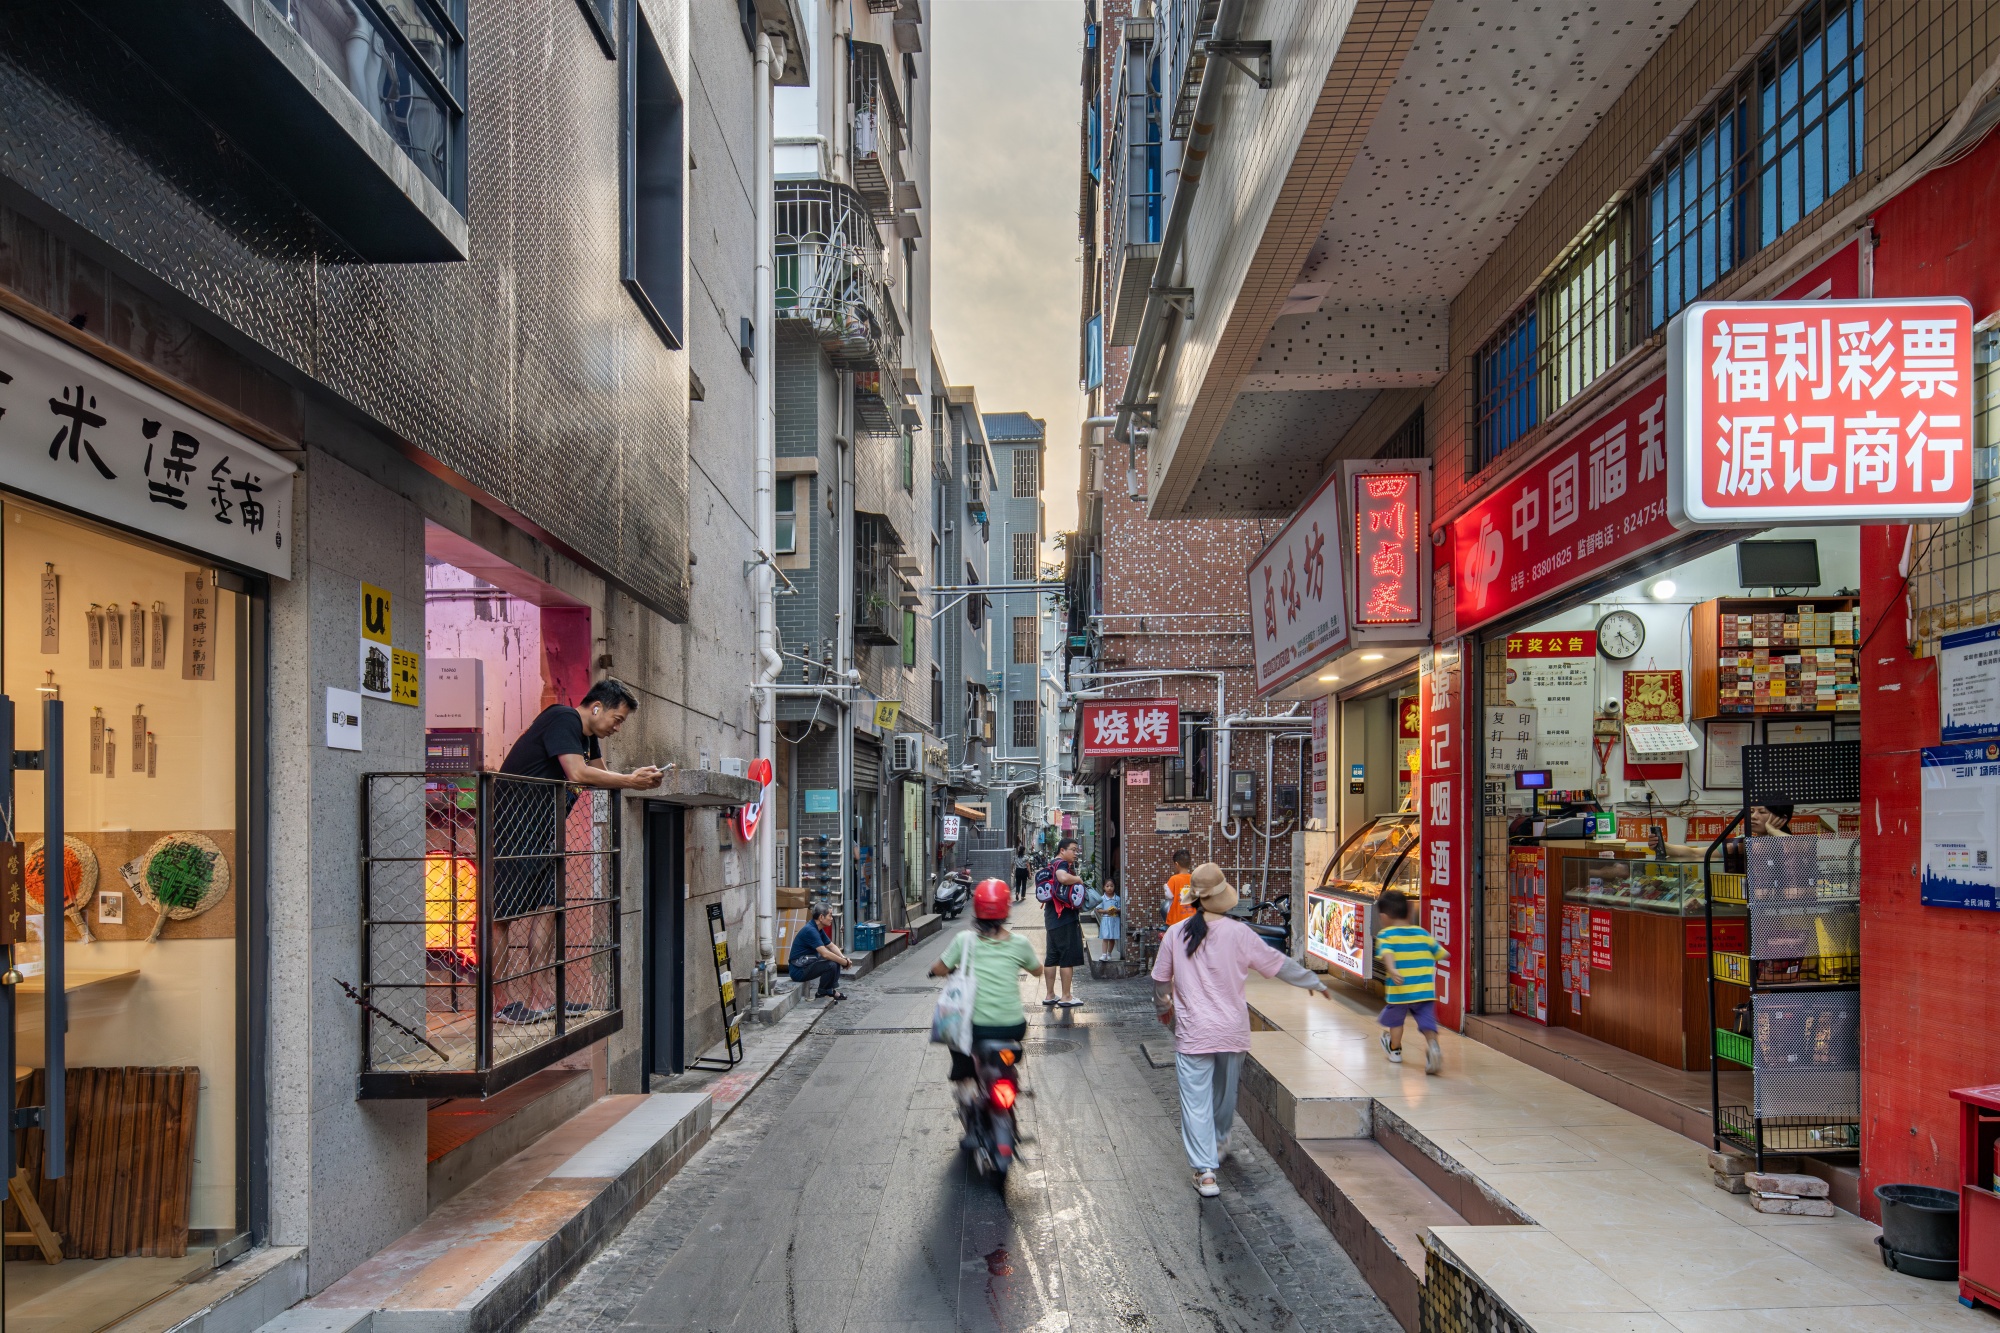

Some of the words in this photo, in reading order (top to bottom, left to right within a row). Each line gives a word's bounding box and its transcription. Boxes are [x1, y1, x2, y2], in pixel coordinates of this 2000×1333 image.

[1712, 318, 1958, 404] 福利彩票
[1716, 410, 1963, 496] 源记商行
[1577, 496, 1669, 560] 监督电话：824754
[1366, 477, 1412, 618] 四川卤菜
[1263, 521, 1325, 643] 卤味坊
[1508, 637, 1584, 653] 开奖公告
[1637, 674, 1668, 705] 福
[1093, 709, 1170, 745] 烧烤
[1492, 712, 1530, 725] 复印
[1491, 730, 1530, 743] 打印
[1490, 747, 1529, 761] 扫描
[1964, 748, 1983, 760] 深圳
[1963, 898, 1991, 909] 全民消防
